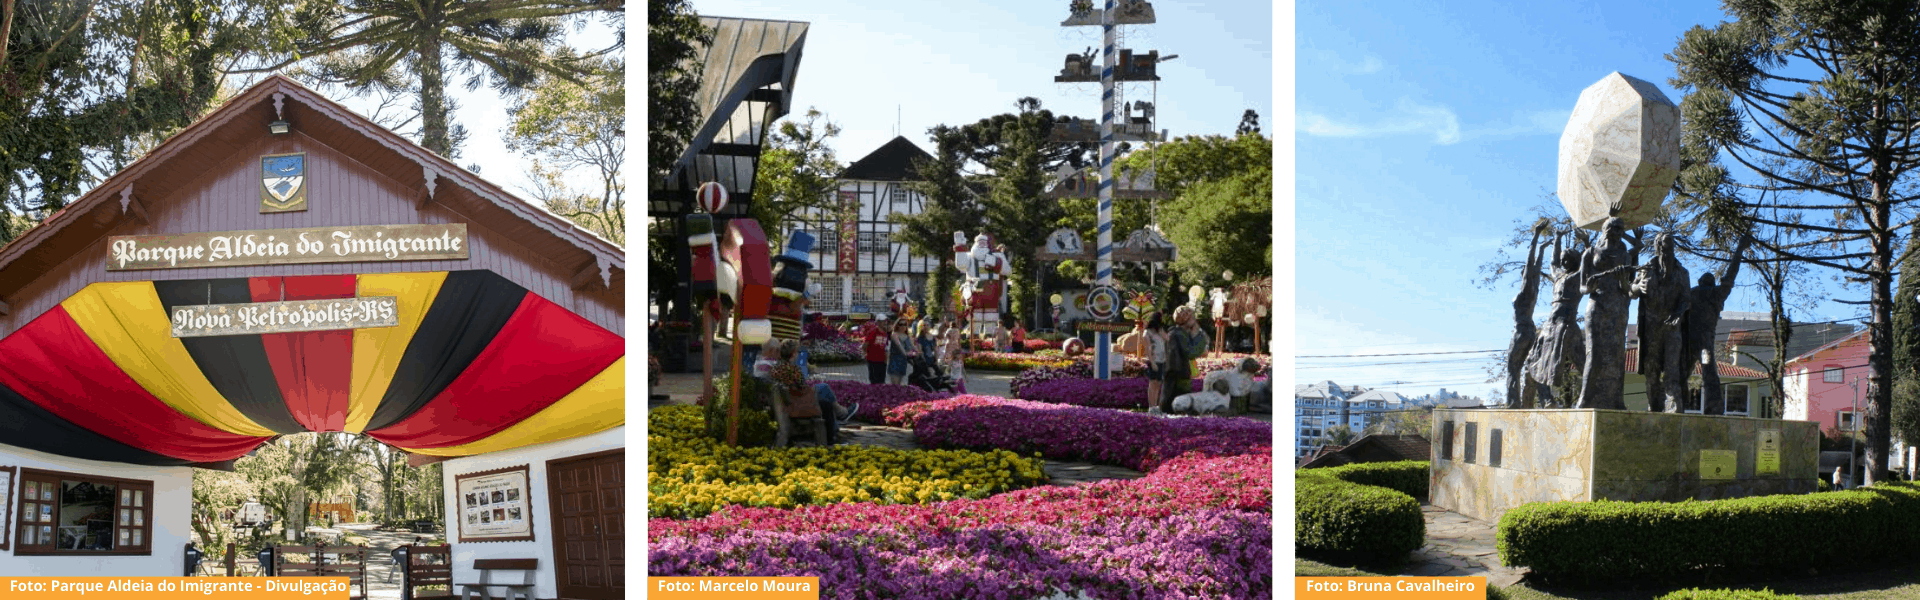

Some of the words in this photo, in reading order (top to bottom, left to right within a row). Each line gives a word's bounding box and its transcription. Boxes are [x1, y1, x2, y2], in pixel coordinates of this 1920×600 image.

[112, 240, 204, 268] Parque
[209, 234, 289, 261] Aldeia
[296, 232, 324, 255] do
[331, 230, 462, 259] Imigrante
[175, 309, 233, 330] Nova
